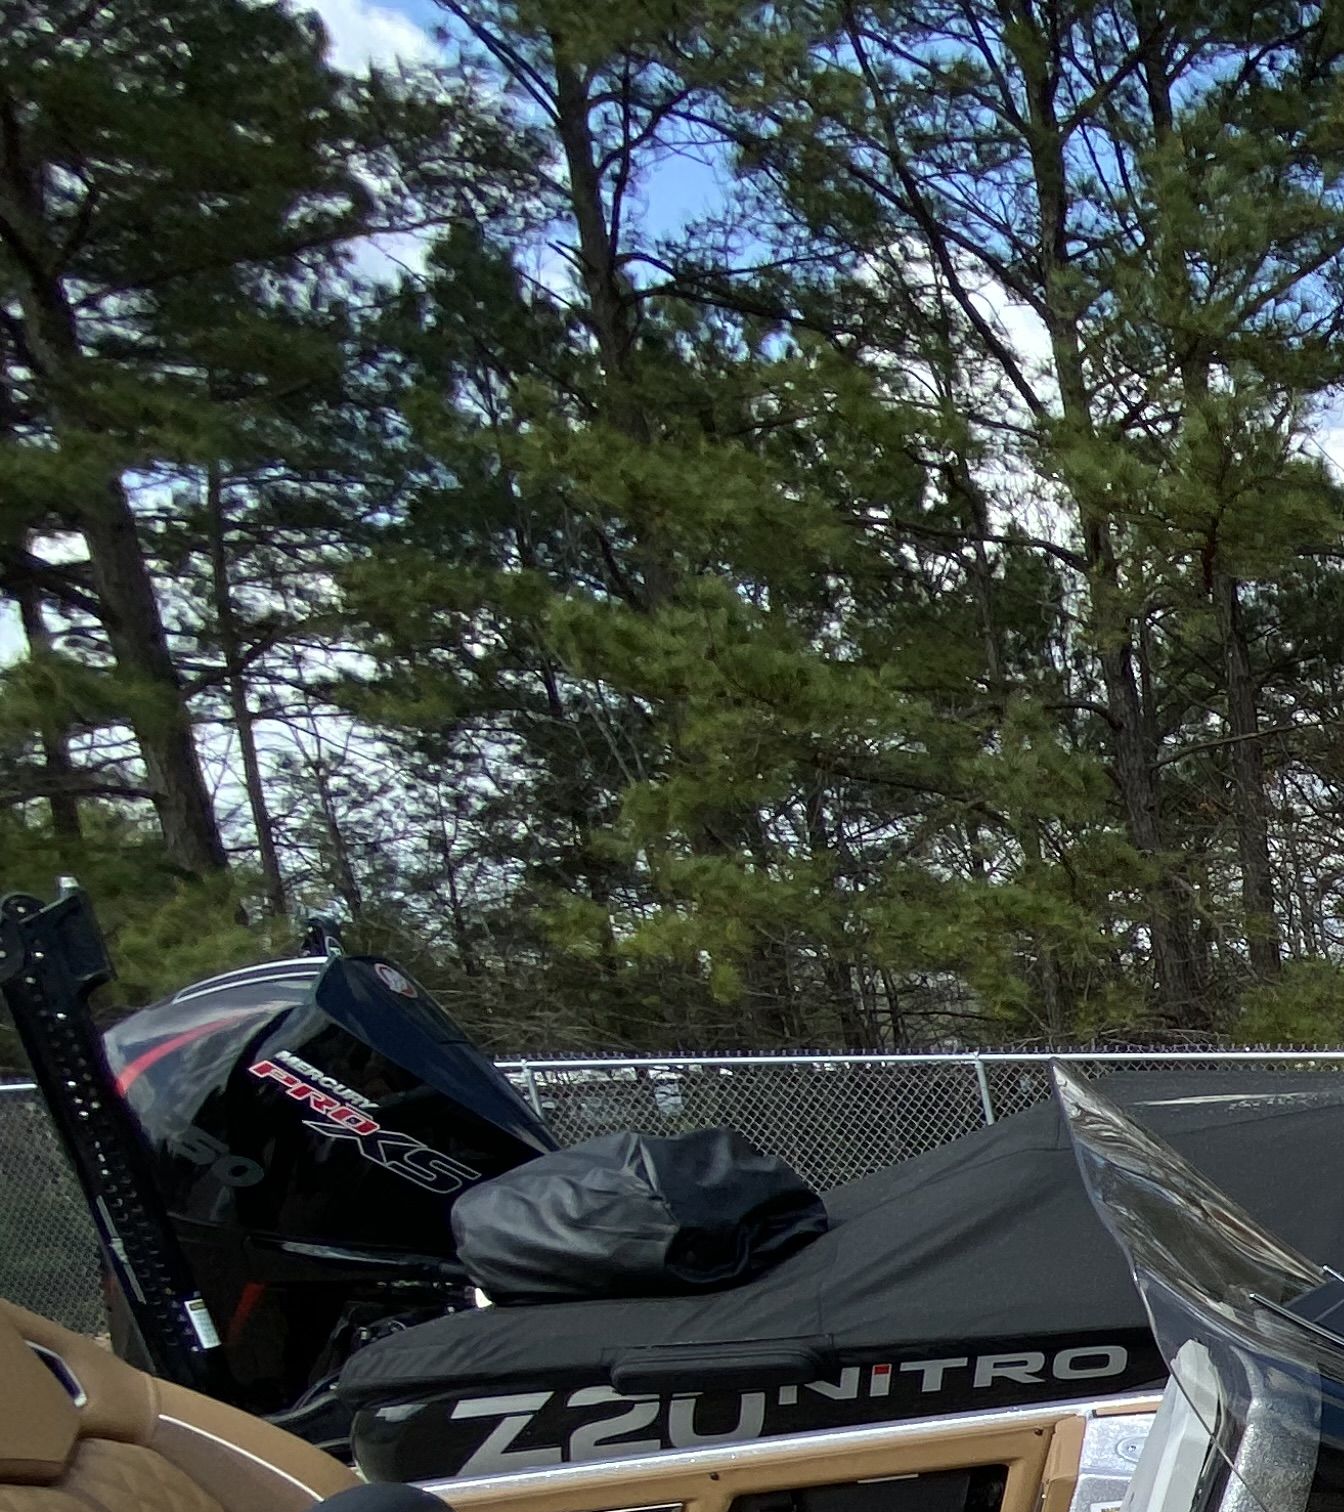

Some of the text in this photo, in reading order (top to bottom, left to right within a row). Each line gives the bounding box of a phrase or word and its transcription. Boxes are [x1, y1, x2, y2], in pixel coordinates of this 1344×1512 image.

[248, 1060, 381, 1136] PRO
[274, 1051, 380, 1109] MERCURY
[302, 1119, 482, 1194] XS
